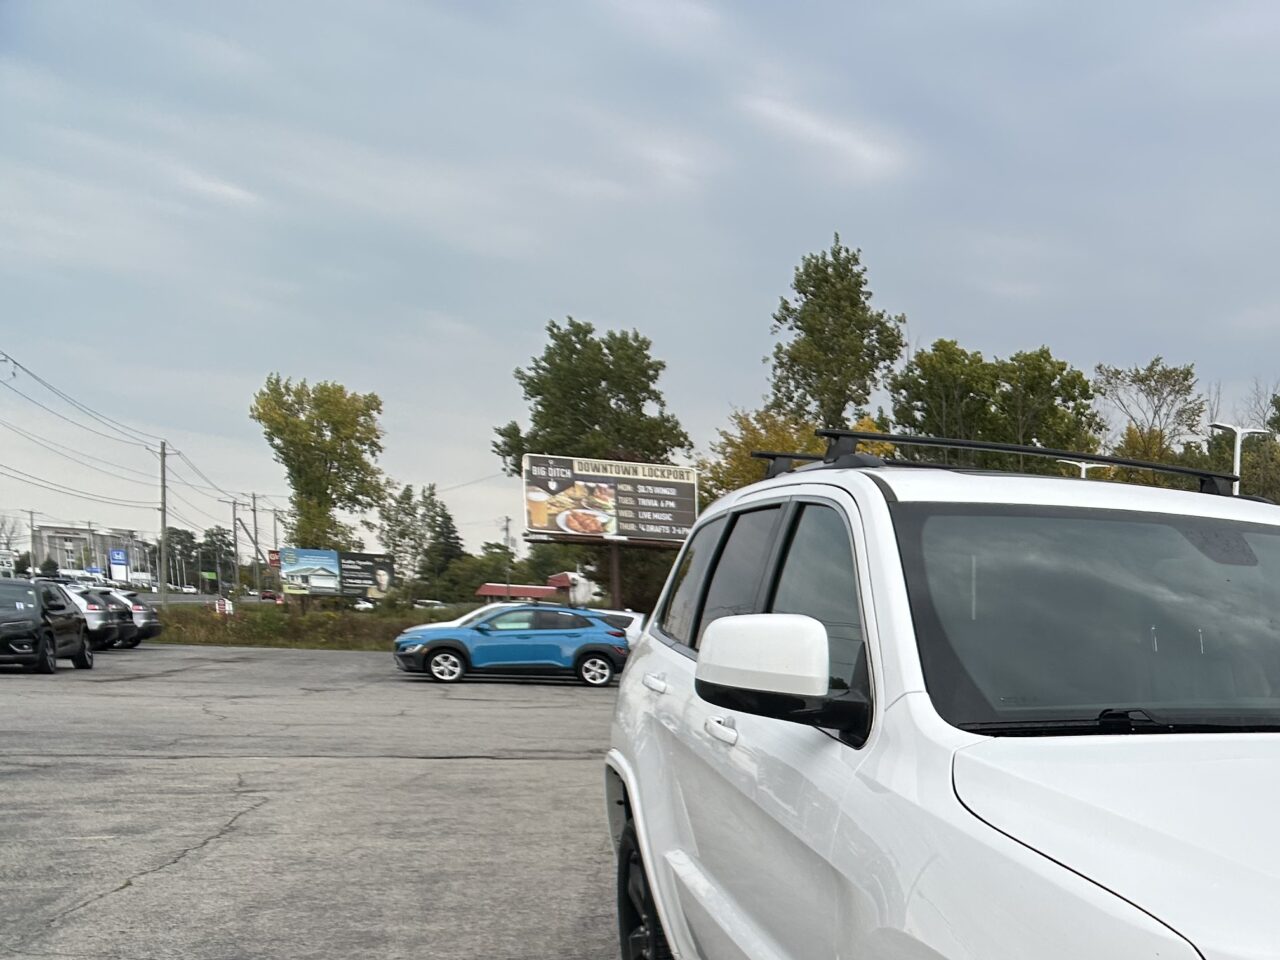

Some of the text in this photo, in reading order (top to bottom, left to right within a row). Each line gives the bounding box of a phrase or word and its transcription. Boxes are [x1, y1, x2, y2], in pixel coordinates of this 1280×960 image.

[531, 465, 572, 478] BIG DITCH
[577, 461, 691, 481] DOWNTOWN LOCKPORT
[638, 498, 659, 507] TRIVIA
[638, 511, 652, 519] LIVE
[652, 512, 673, 520] MUSIC
